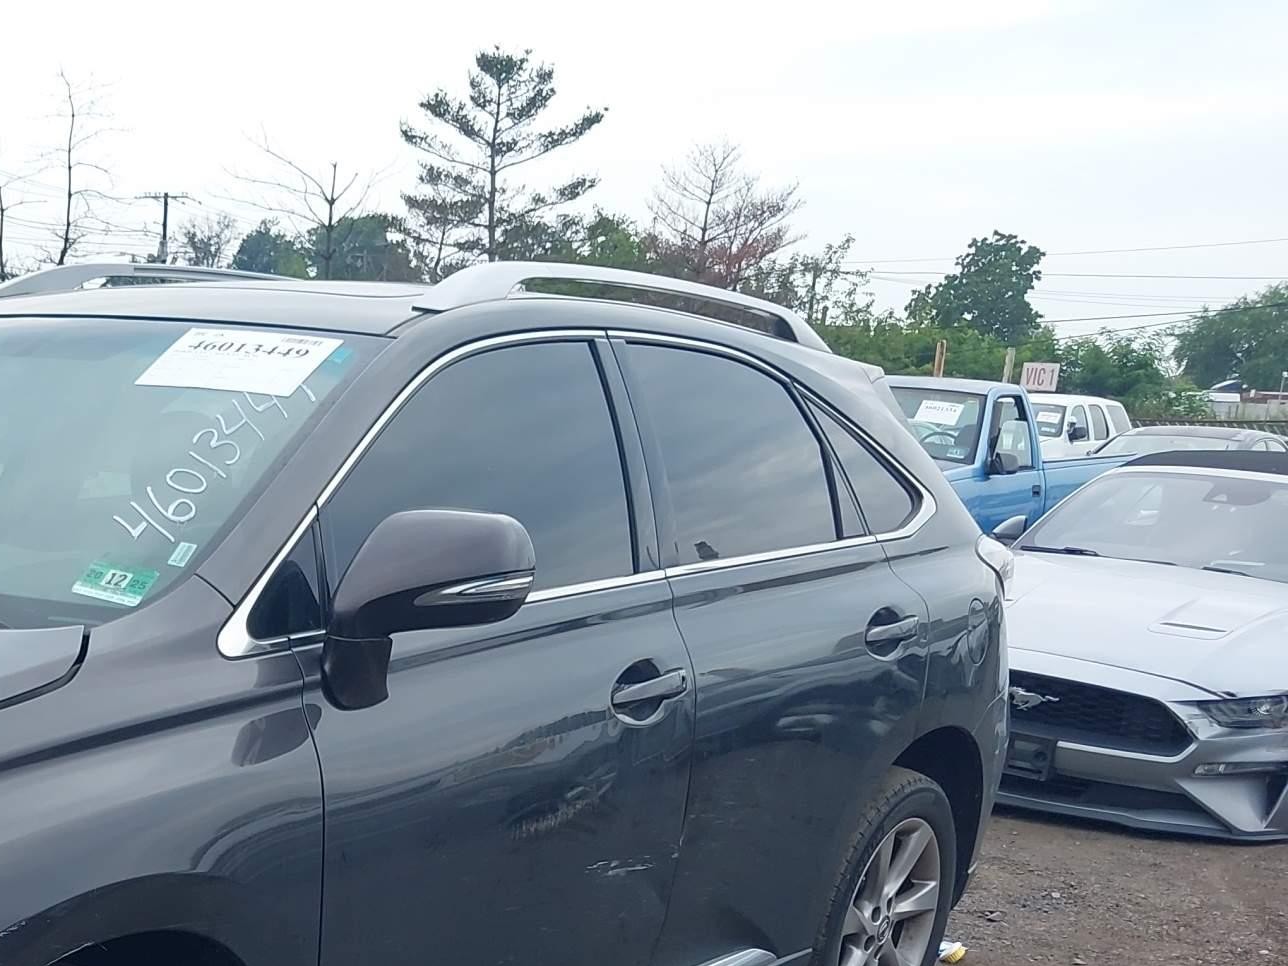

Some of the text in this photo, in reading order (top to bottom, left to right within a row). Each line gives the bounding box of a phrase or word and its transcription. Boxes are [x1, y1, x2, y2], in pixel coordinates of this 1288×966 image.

[188, 339, 310, 358] 46013449
[1026, 367, 1055, 386] VIC 1
[104, 572, 129, 588] 12
